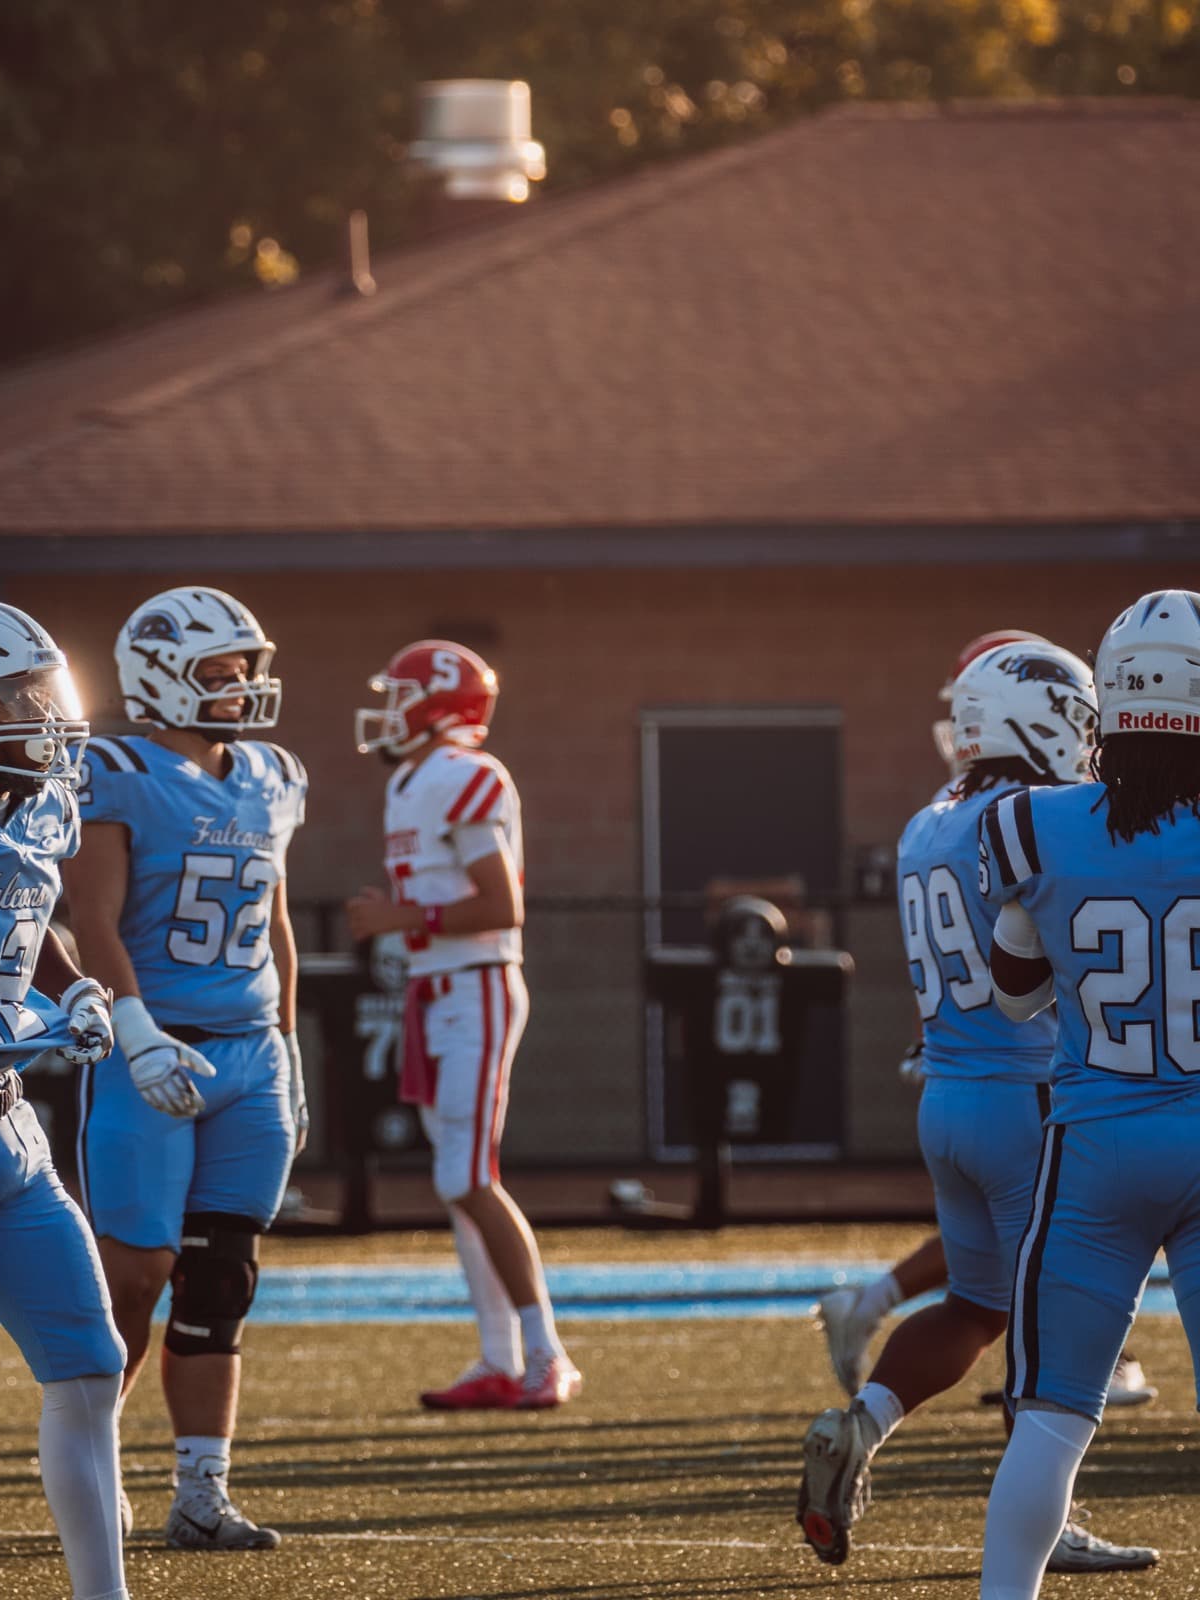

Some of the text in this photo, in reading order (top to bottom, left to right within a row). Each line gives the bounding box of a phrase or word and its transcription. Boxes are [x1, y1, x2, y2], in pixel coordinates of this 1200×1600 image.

[431, 650, 461, 691] S
[1127, 674, 1145, 691] 26
[1118, 711, 1200, 733] Riddell
[166, 852, 280, 971] 52
[902, 864, 993, 1022] 99
[357, 1019, 404, 1081] 7
